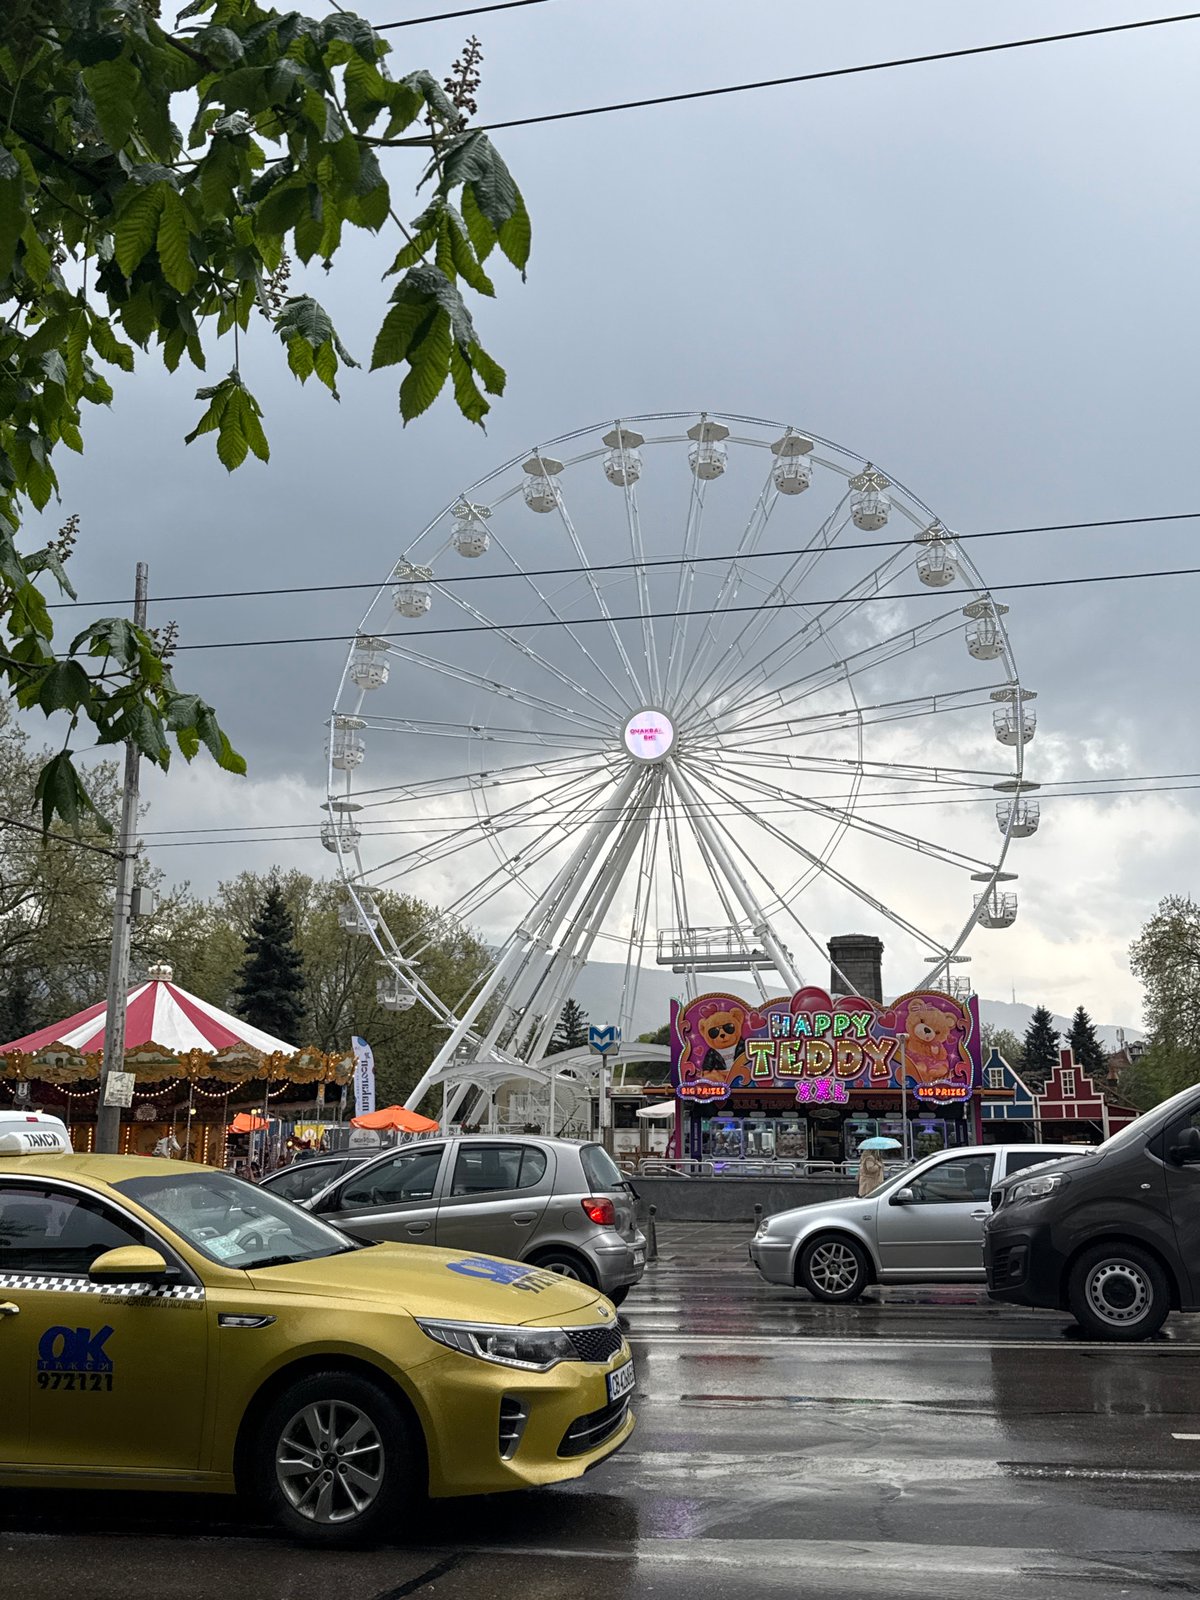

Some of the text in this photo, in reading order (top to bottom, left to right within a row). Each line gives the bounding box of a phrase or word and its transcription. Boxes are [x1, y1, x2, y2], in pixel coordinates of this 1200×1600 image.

[770, 1013, 873, 1038] HAPPY
[748, 1040, 896, 1076] TEDDY
[681, 1087, 726, 1095] BIG PRIZES
[797, 1078, 848, 1102] XXL
[918, 1088, 966, 1096] BIG PRIZES
[23, 1133, 60, 1147] ТАКСИ
[42, 1360, 110, 1371] ТАКСИ
[37, 1372, 113, 1392] 972121
